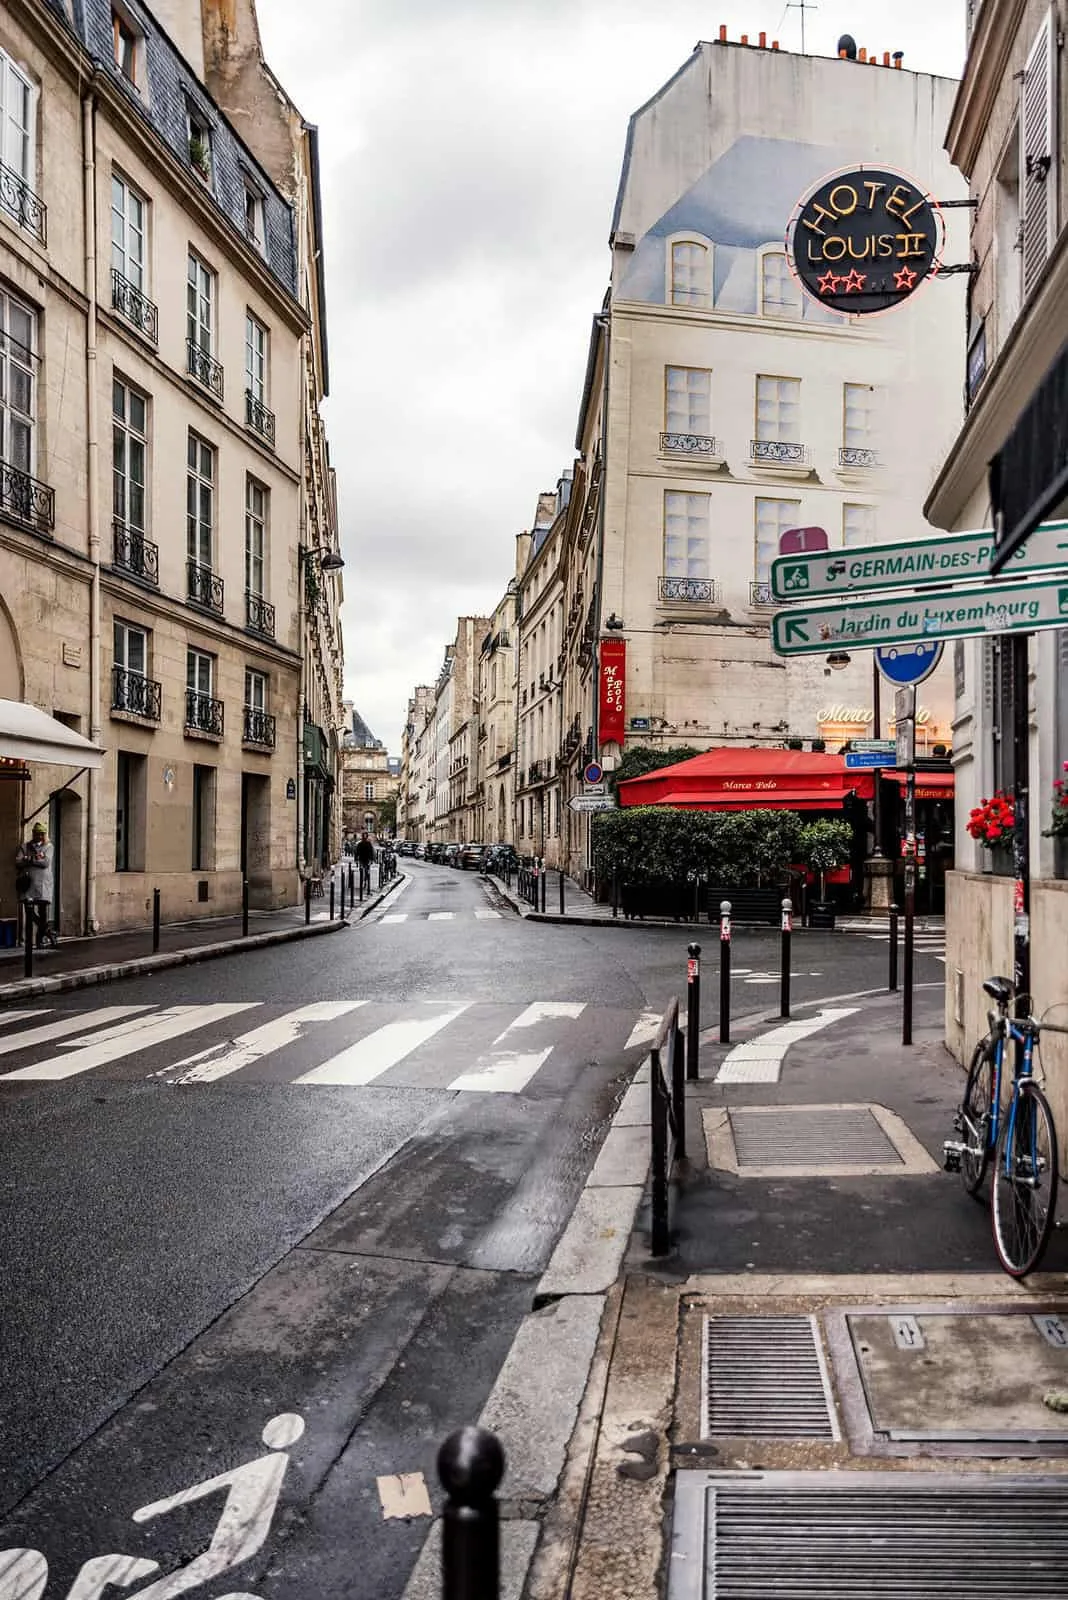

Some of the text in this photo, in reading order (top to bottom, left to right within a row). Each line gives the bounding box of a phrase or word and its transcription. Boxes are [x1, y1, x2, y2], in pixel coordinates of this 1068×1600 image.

[802, 181, 926, 236] HOTEL
[808, 234, 895, 261] LOUIS
[836, 614, 891, 634] Jardin
[897, 611, 919, 628] du
[603, 665, 618, 703] Marco
[816, 703, 875, 723] Marco
[722, 781, 752, 790] Marco
